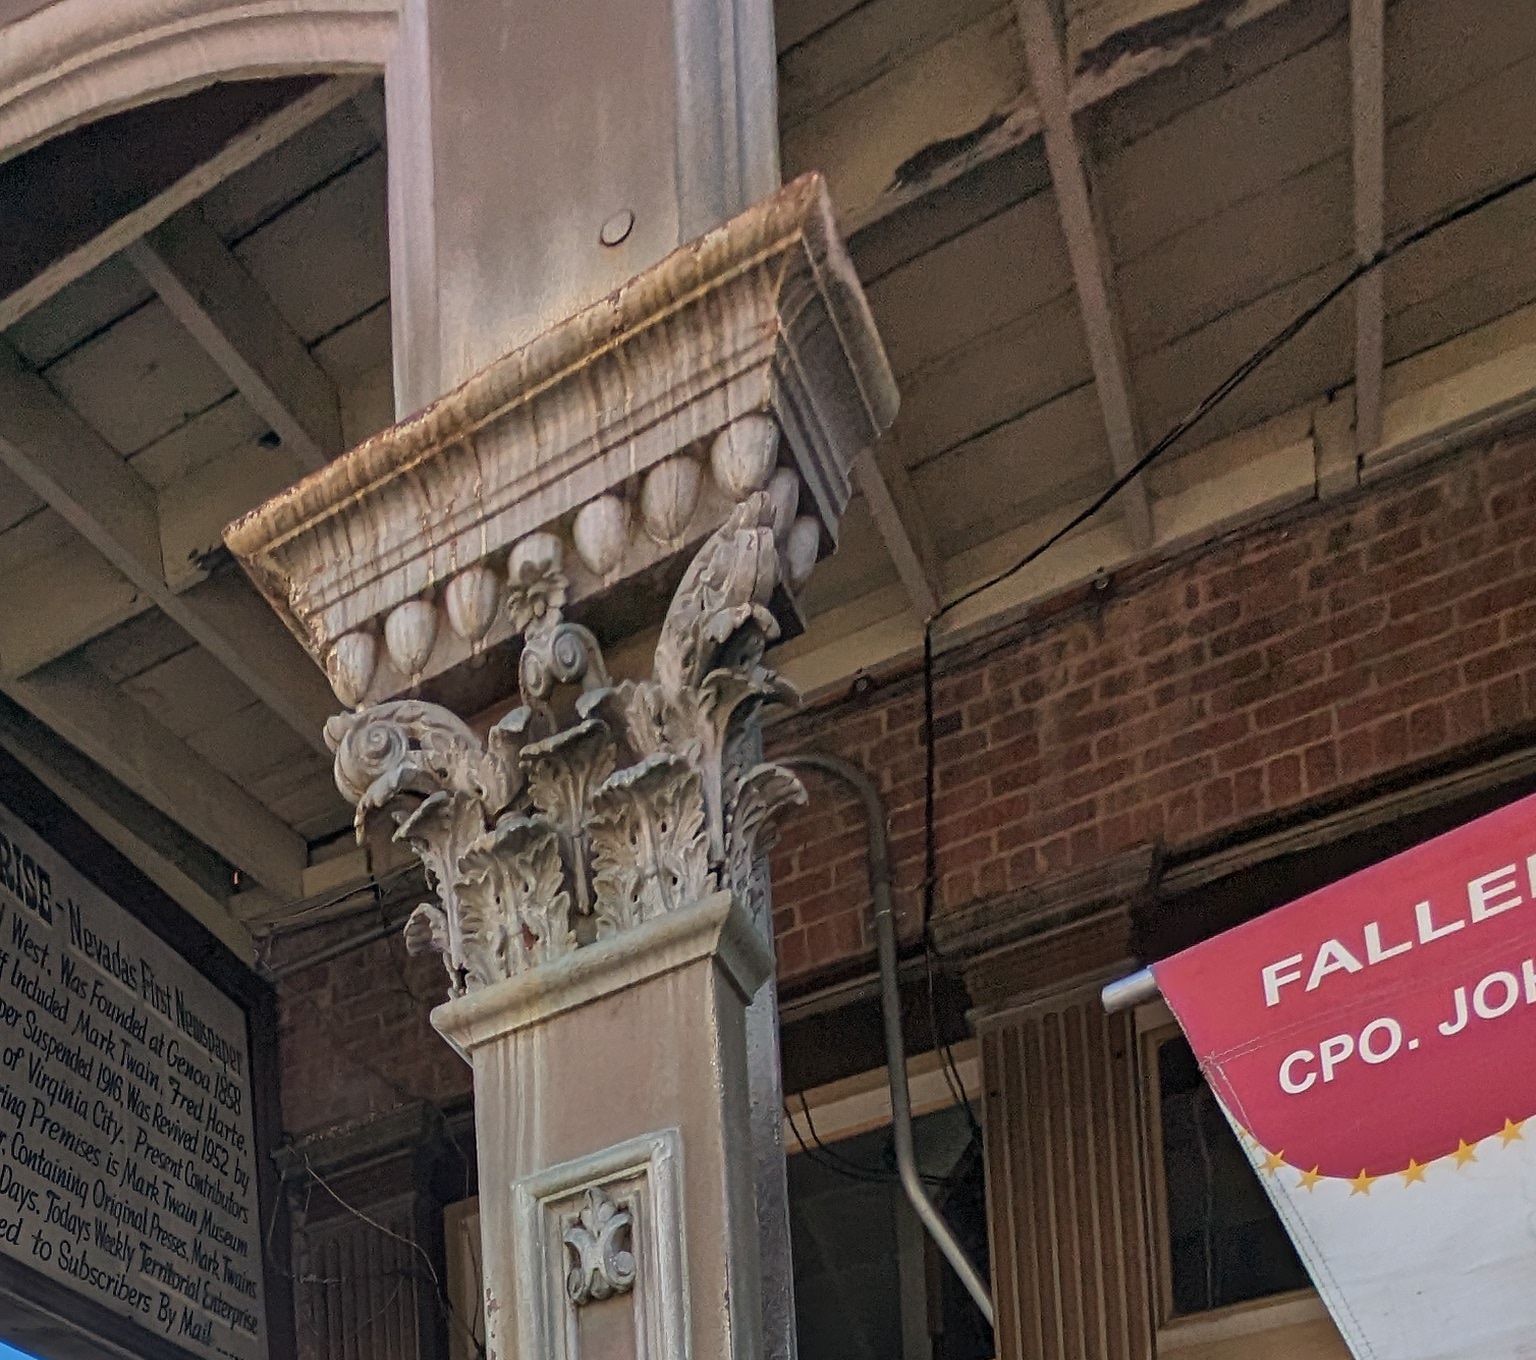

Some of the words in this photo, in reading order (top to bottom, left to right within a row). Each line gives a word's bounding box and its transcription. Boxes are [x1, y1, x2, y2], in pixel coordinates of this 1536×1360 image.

[9, 957, 71, 1025] Included
[70, 1008, 116, 1062] Mark
[167, 1074, 205, 1124] Fred
[201, 1097, 248, 1157] Harte,
[59, 951, 89, 1000] Was
[88, 978, 149, 1045] Founded
[145, 1019, 165, 1059] at
[165, 1038, 211, 1094] Genoa
[212, 1071, 242, 1117] 1858
[138, 956, 173, 1021] First
[174, 985, 242, 1075] Newspaper
[1278, 1017, 1420, 1095] CPO.
[1, 1045, 26, 1072] of
[27, 1051, 89, 1121] Virginia
[132, 1124, 184, 1181] Present
[183, 1159, 249, 1225] Contributors
[21, 1008, 95, 1083] Suspended
[126, 1080, 151, 1124] Was
[150, 1101, 200, 1155] Revived
[200, 1134, 230, 1177] 1952
[232, 1155, 250, 1198] by
[28, 1095, 102, 1168] Premises
[104, 1150, 120, 1178] is
[118, 1156, 160, 1206] Mark
[161, 1179, 198, 1228] Twain
[196, 1207, 248, 1258] Museum
[9, 1130, 89, 1209] Containing
[91, 1177, 150, 1247] Original
[190, 1236, 221, 1281] Mark
[30, 1227, 53, 1262] to
[56, 1238, 153, 1314] Subscribers
[156, 1289, 178, 1333] By
[42, 1188, 91, 1245] Todays
[93, 1216, 136, 1274] Weekly
[138, 1240, 202, 1303] Territorial
[201, 1279, 258, 1335] Enterprise
